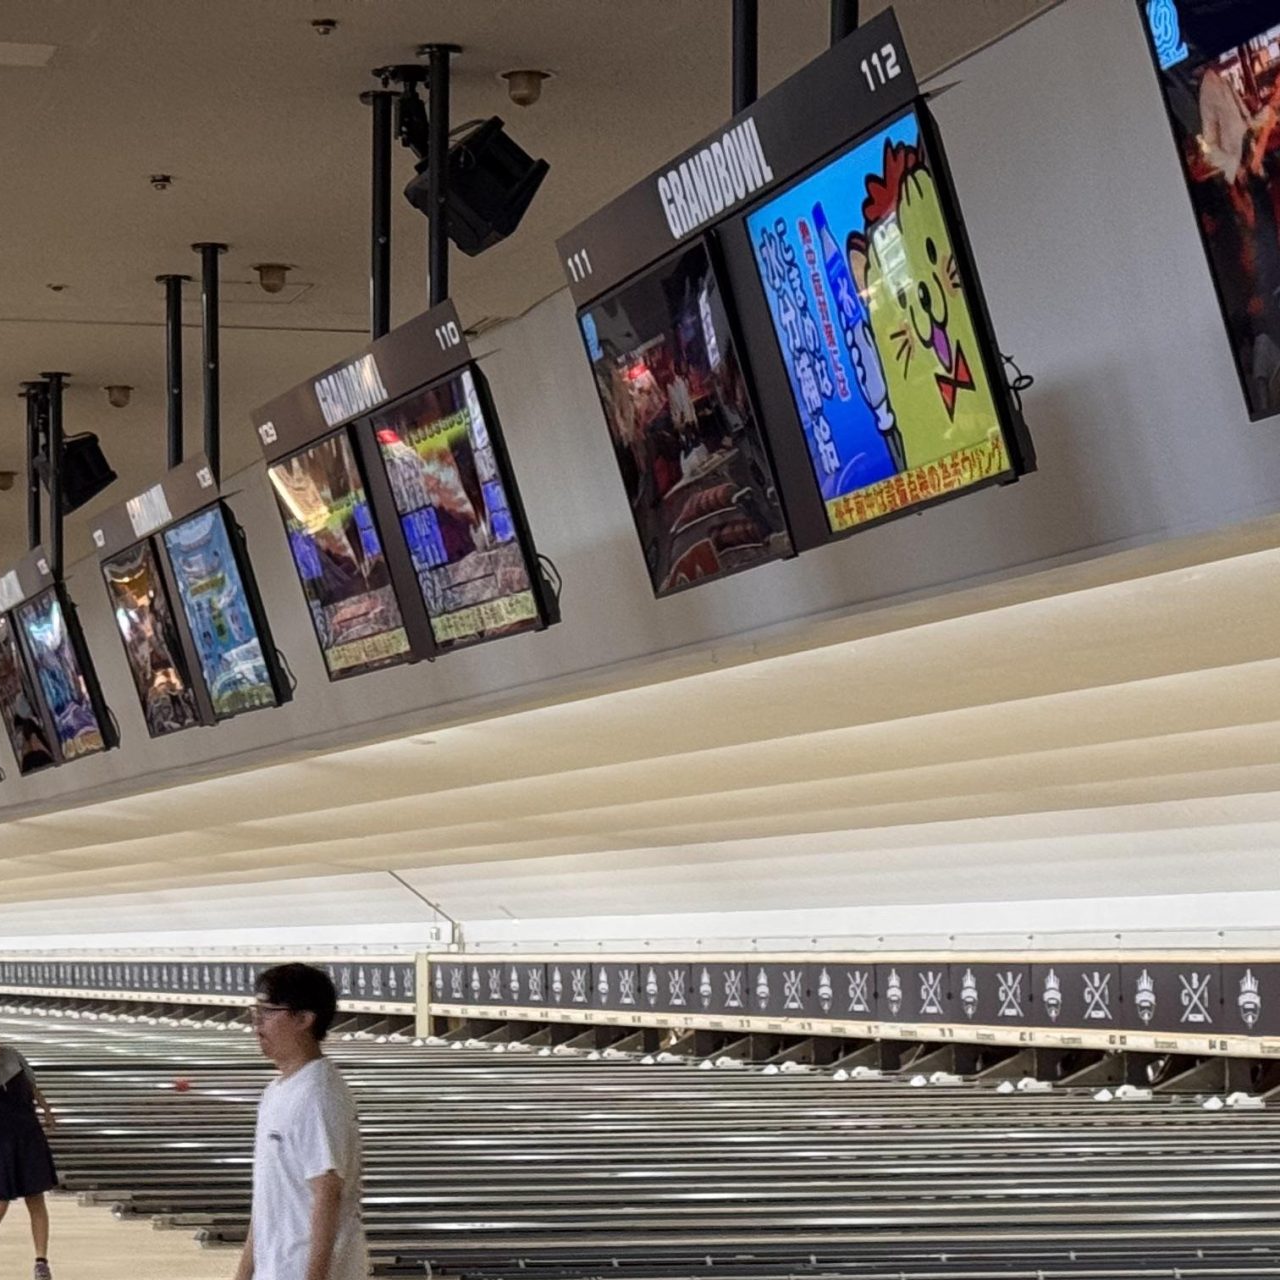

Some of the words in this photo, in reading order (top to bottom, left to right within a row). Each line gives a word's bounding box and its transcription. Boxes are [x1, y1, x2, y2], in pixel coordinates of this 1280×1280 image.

[861, 43, 901, 91] 112
[658, 116, 773, 239] GRANDBOWL
[568, 249, 592, 282] 111
[776, 218, 833, 398] こまめな
[435, 321, 460, 350] 110
[761, 228, 839, 475] 水分補給
